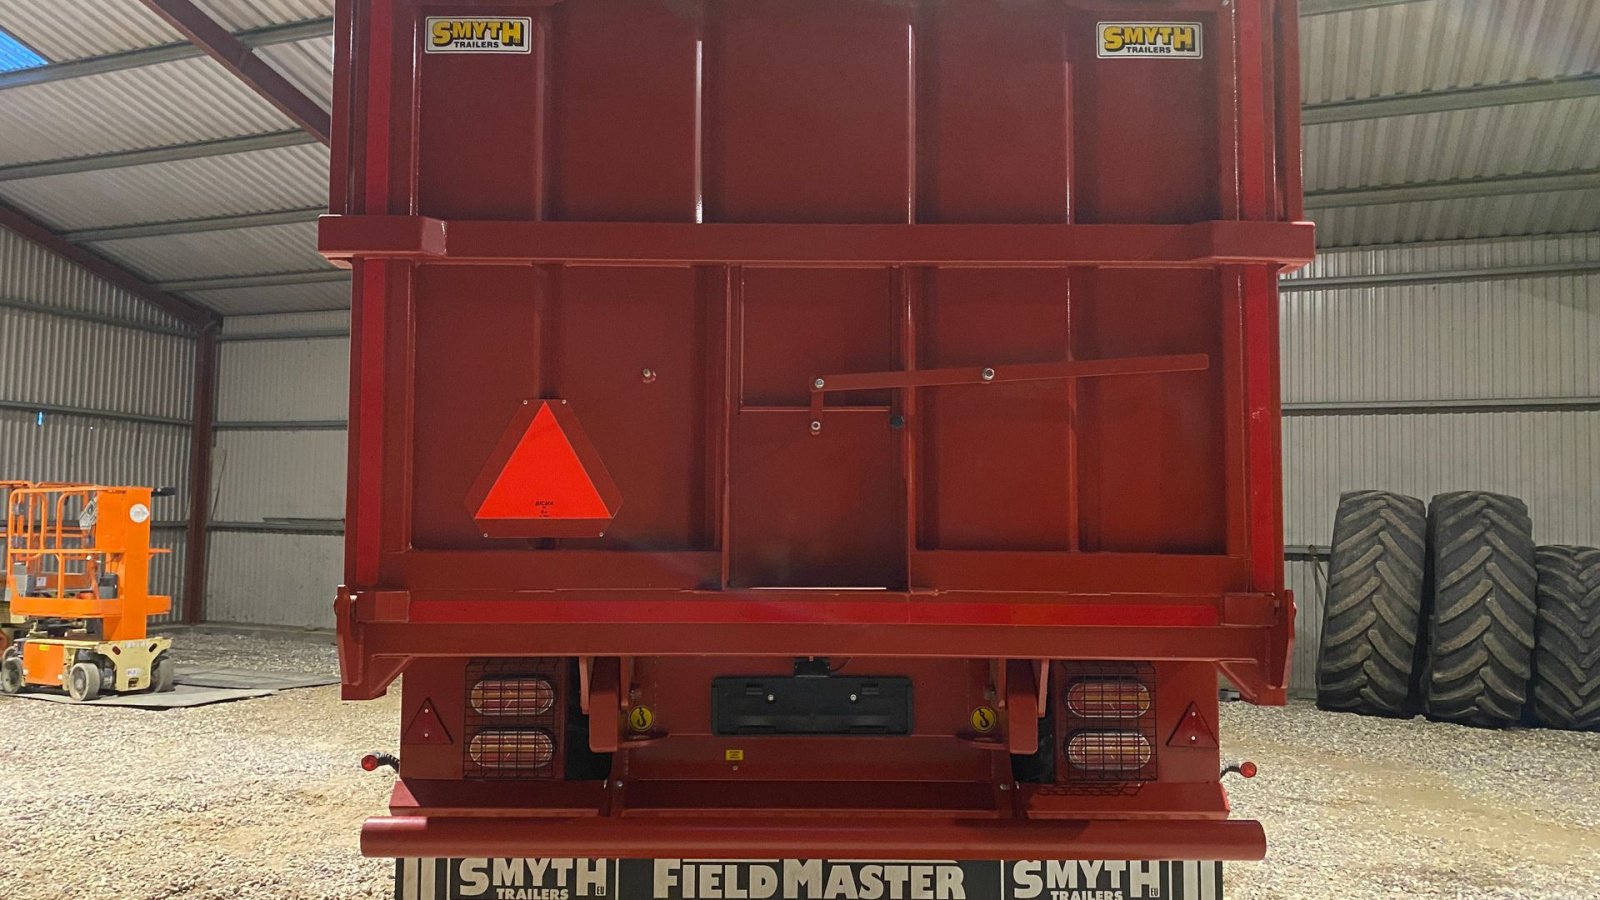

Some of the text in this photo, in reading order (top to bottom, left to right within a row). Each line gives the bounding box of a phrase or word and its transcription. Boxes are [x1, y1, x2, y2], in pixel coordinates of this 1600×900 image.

[432, 21, 524, 47] SMYTH
[1104, 26, 1195, 52] SMYTH
[459, 857, 607, 896] SMYTH
[1012, 859, 1160, 898] SMYTH
[496, 888, 569, 900] TRAILERS
[1050, 890, 1124, 900] TRAILERS
